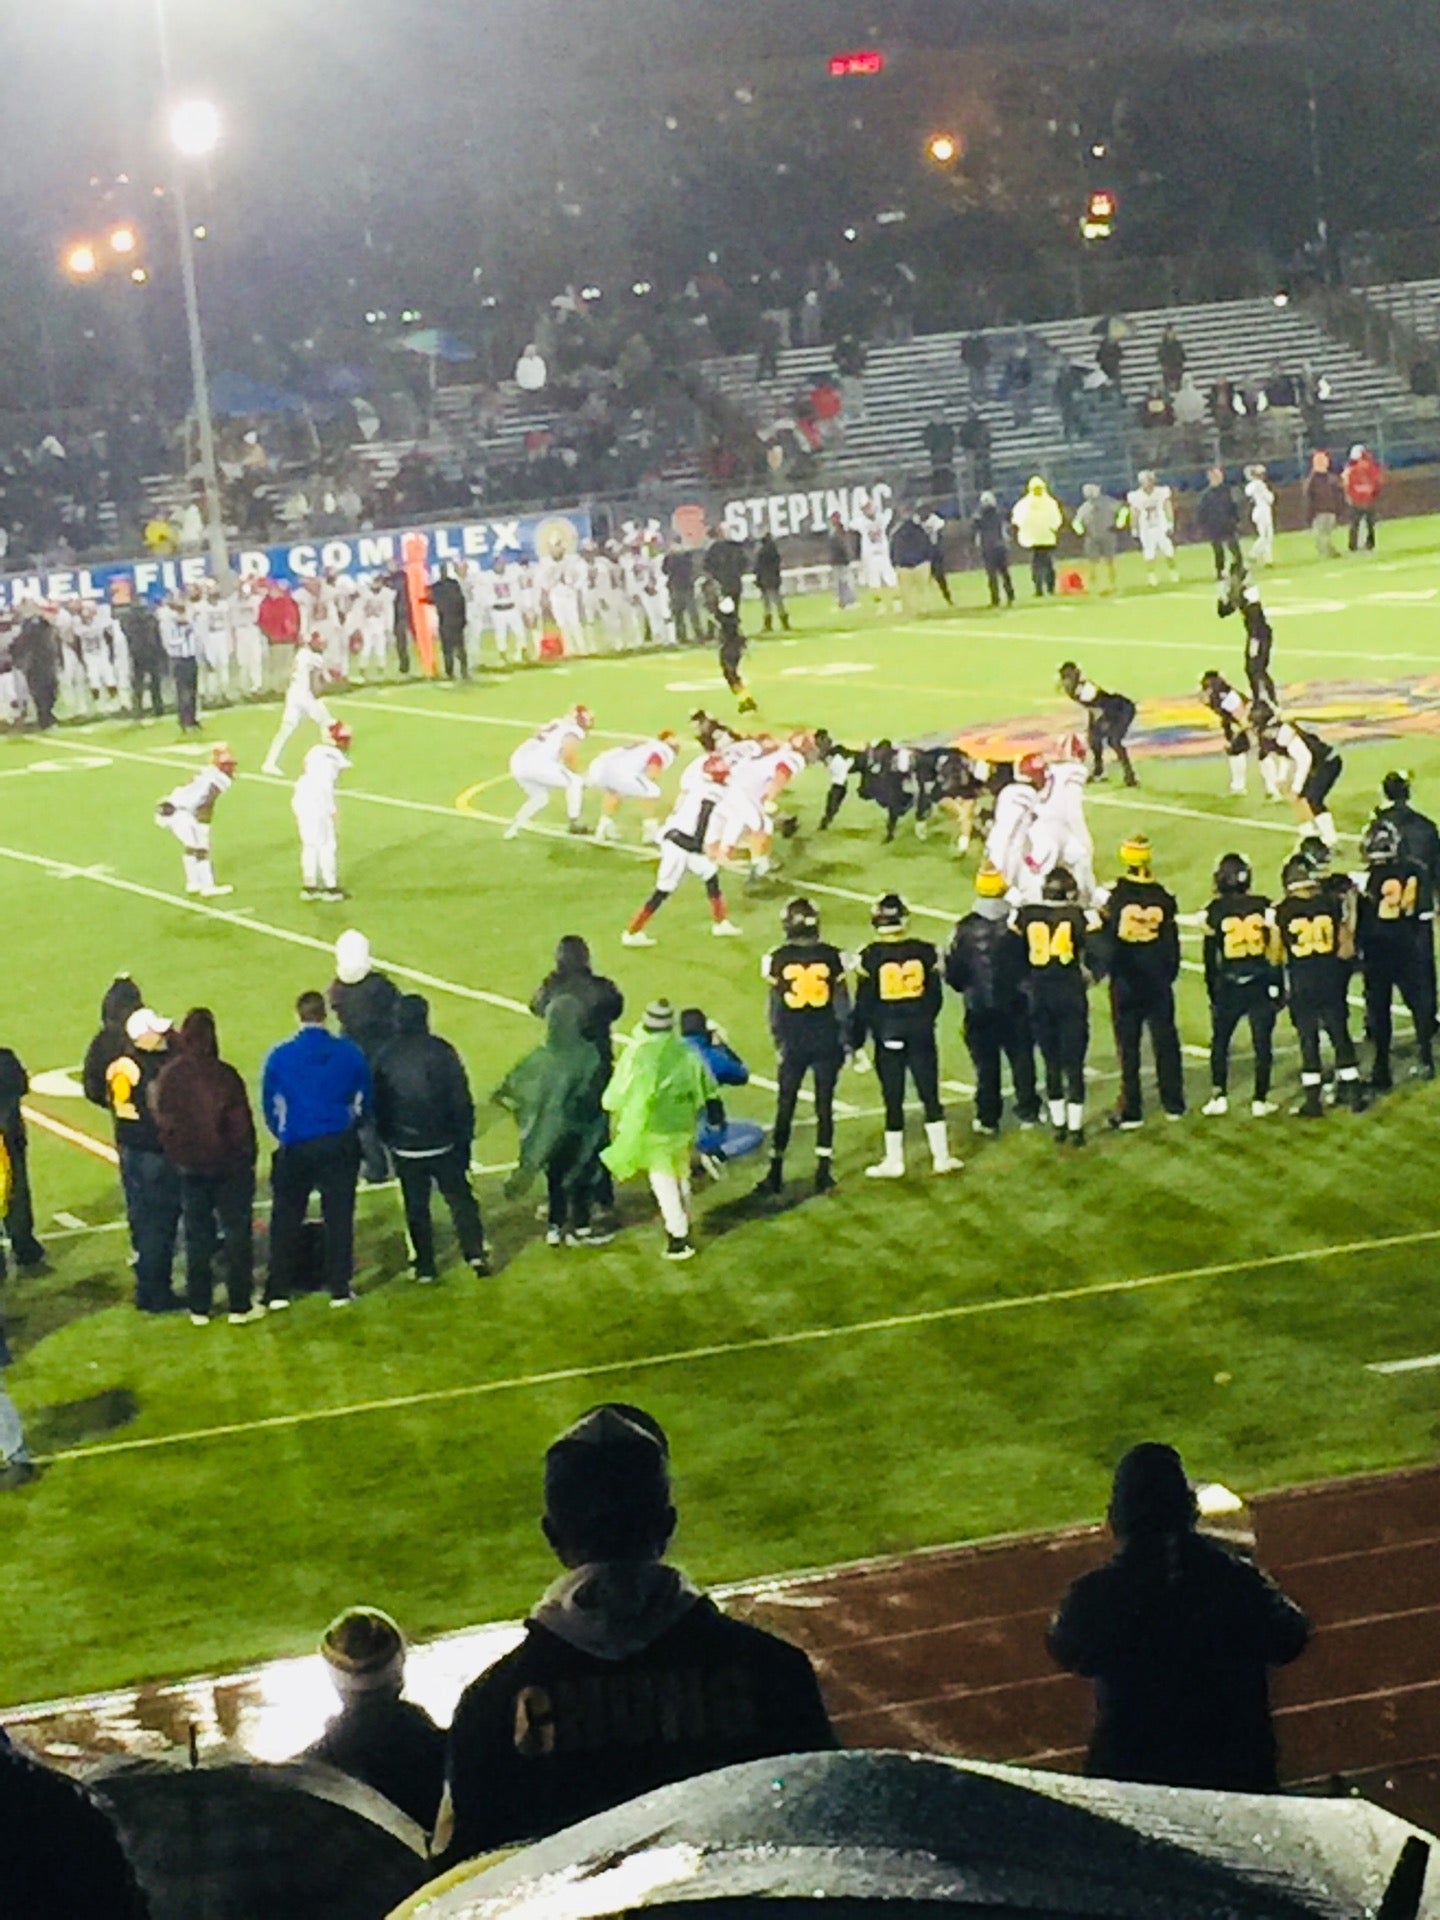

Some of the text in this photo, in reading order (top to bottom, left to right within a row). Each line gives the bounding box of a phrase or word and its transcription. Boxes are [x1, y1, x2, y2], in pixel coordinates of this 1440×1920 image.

[724, 483, 892, 543] STEPINAC
[0, 570, 104, 604] HEL
[133, 551, 270, 593] FIED
[1288, 914, 1334, 958] 30
[783, 963, 830, 1009] 36
